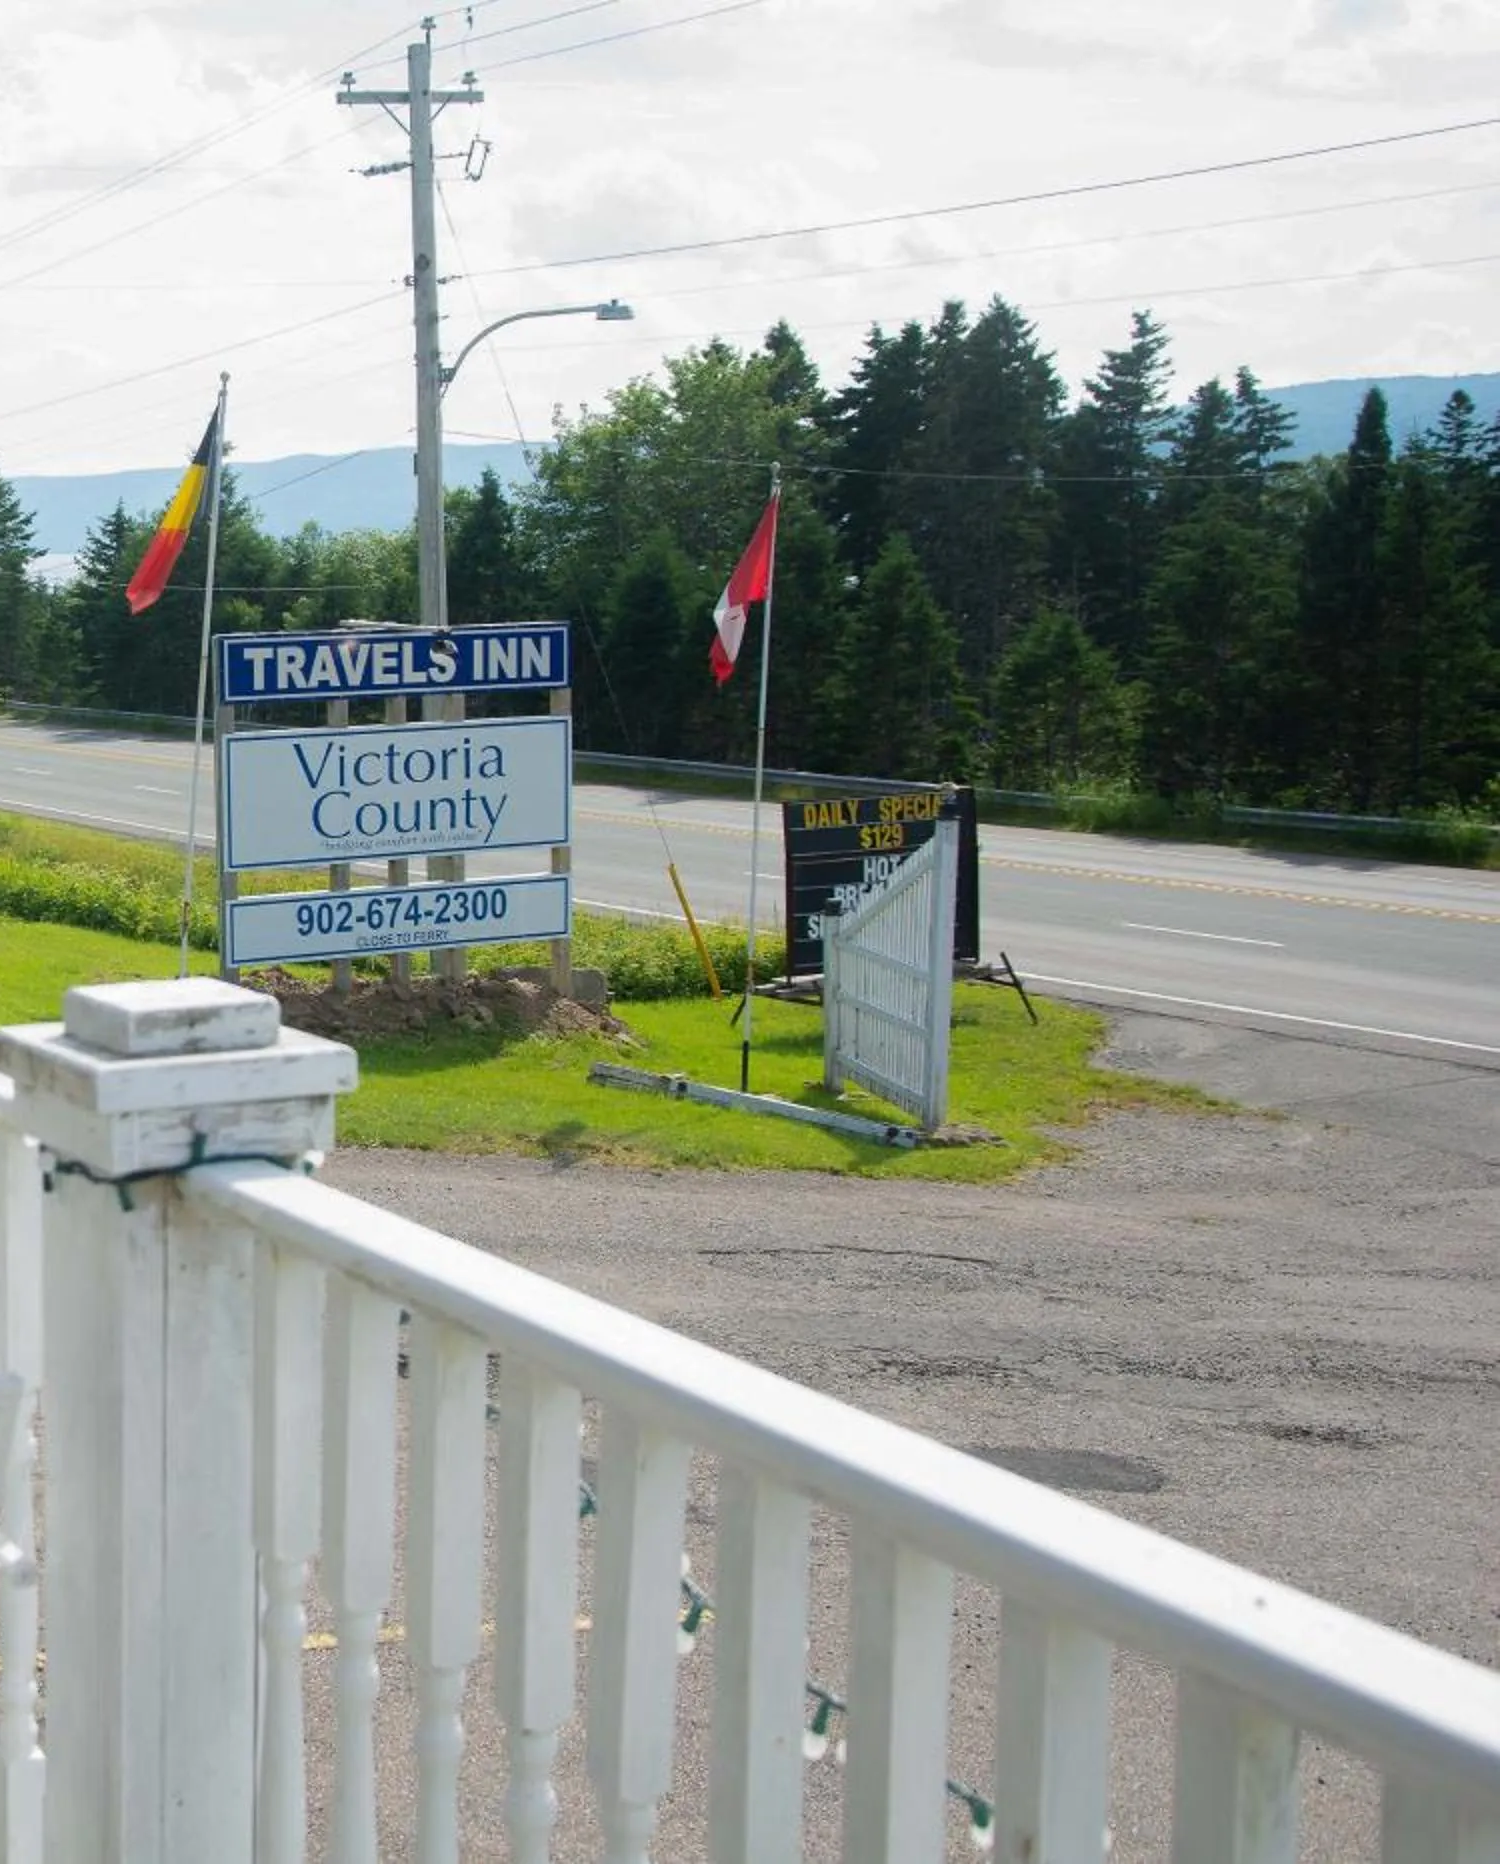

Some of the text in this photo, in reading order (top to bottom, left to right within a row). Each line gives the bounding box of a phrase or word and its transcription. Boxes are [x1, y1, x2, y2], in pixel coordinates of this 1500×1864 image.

[243, 637, 551, 691] TRAVELS INN
[292, 737, 506, 789] Victoria
[312, 789, 507, 843] County
[803, 799, 859, 830] DAILY
[859, 823, 903, 849] $129
[296, 889, 508, 937] 902-674-2300
[356, 929, 449, 947] CLOSE TO FERRY
